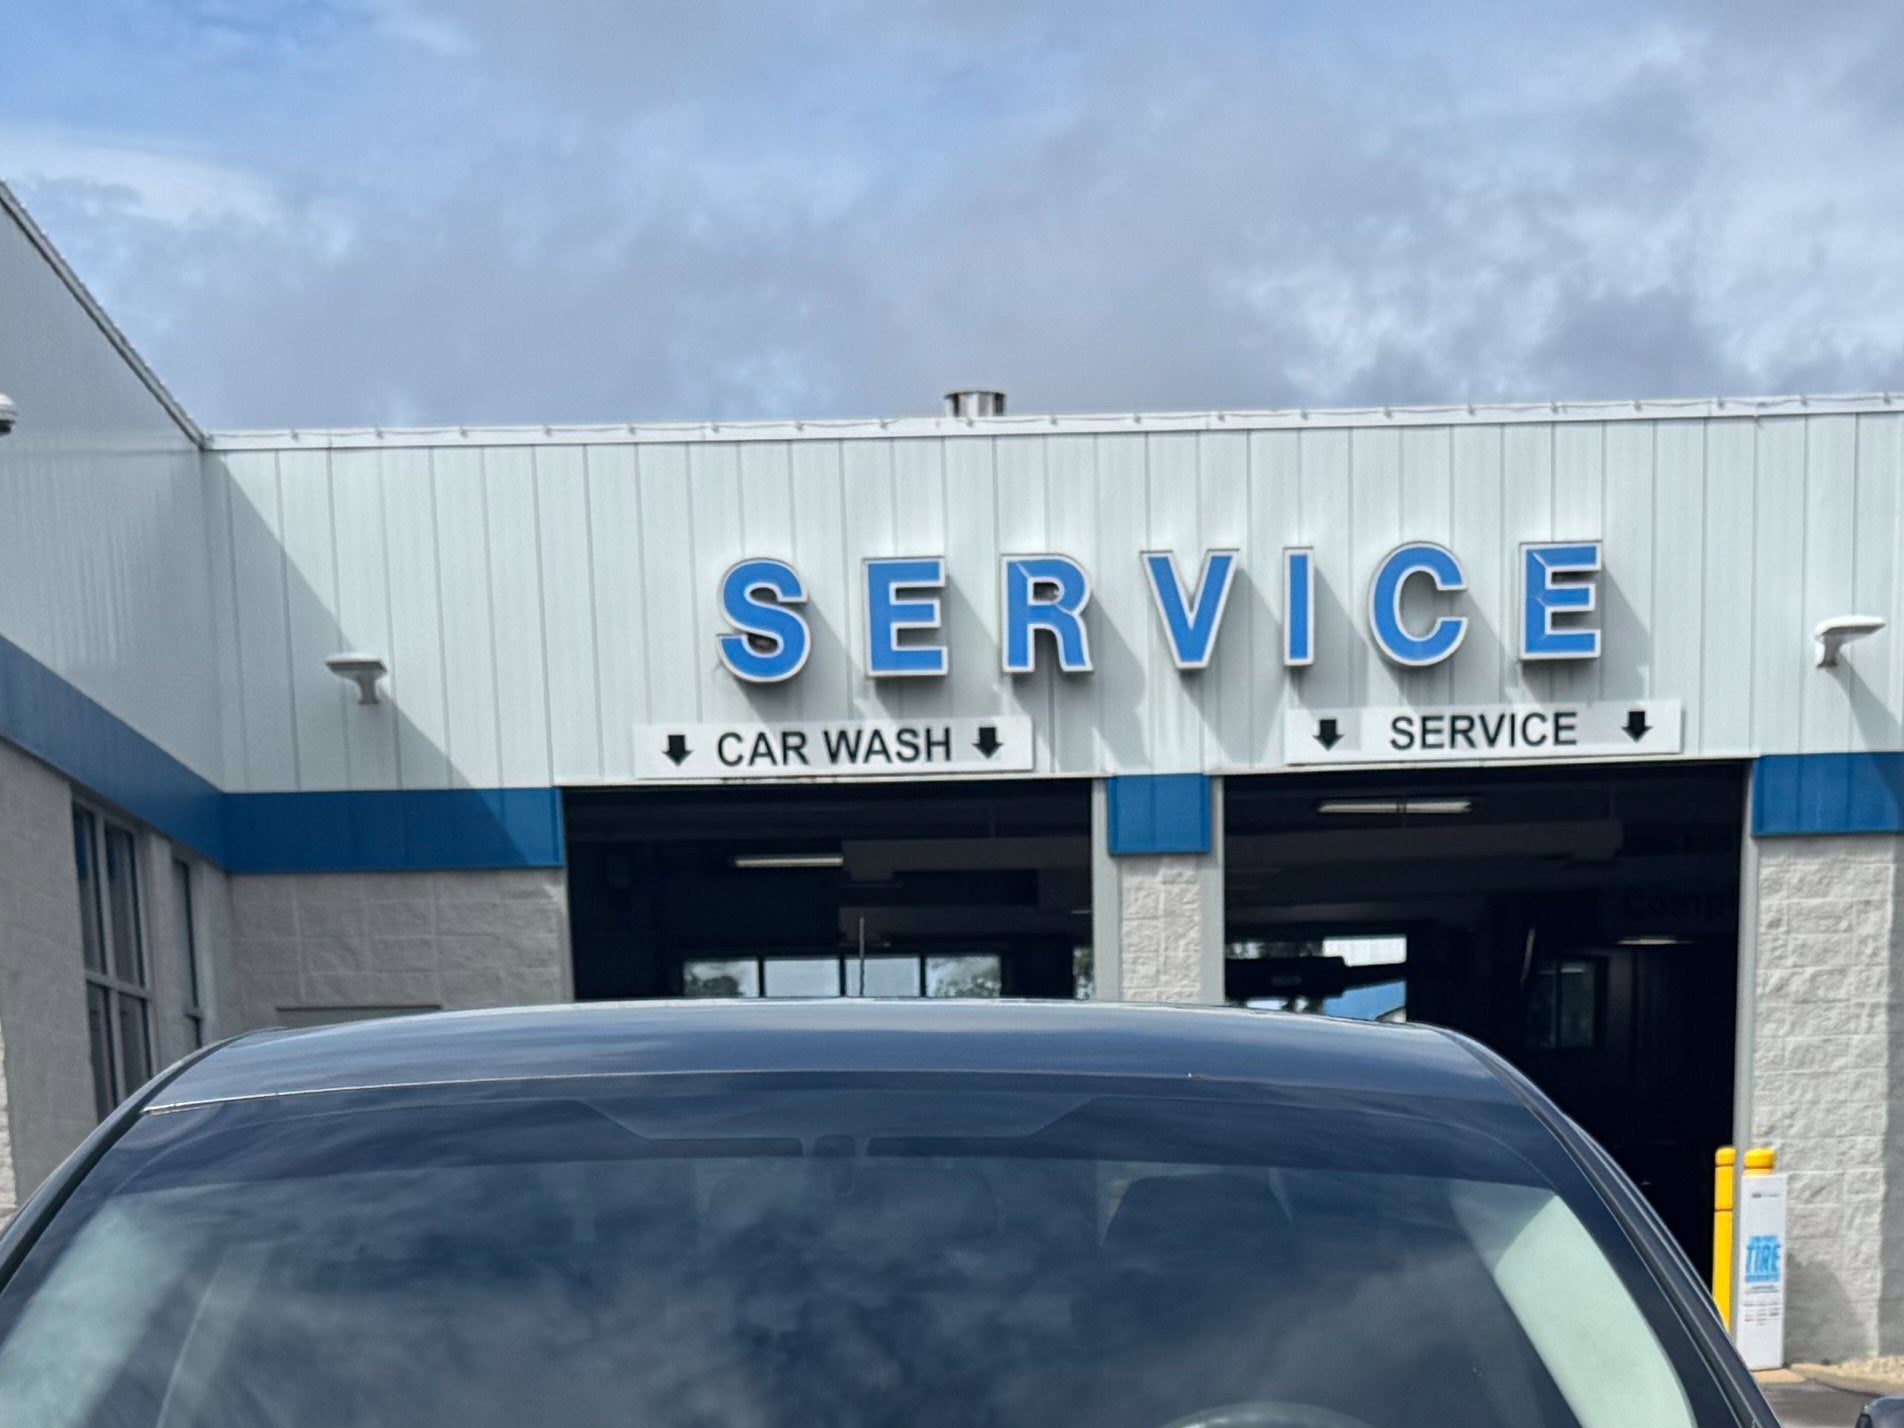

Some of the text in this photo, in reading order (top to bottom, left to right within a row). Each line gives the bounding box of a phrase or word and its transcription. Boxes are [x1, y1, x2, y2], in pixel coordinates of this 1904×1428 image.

[716, 540, 1603, 684] SERVICE
[717, 727, 951, 767] CAR WASH
[1390, 711, 1578, 751] SERVICE
[1746, 1243, 1780, 1276] TIRE
